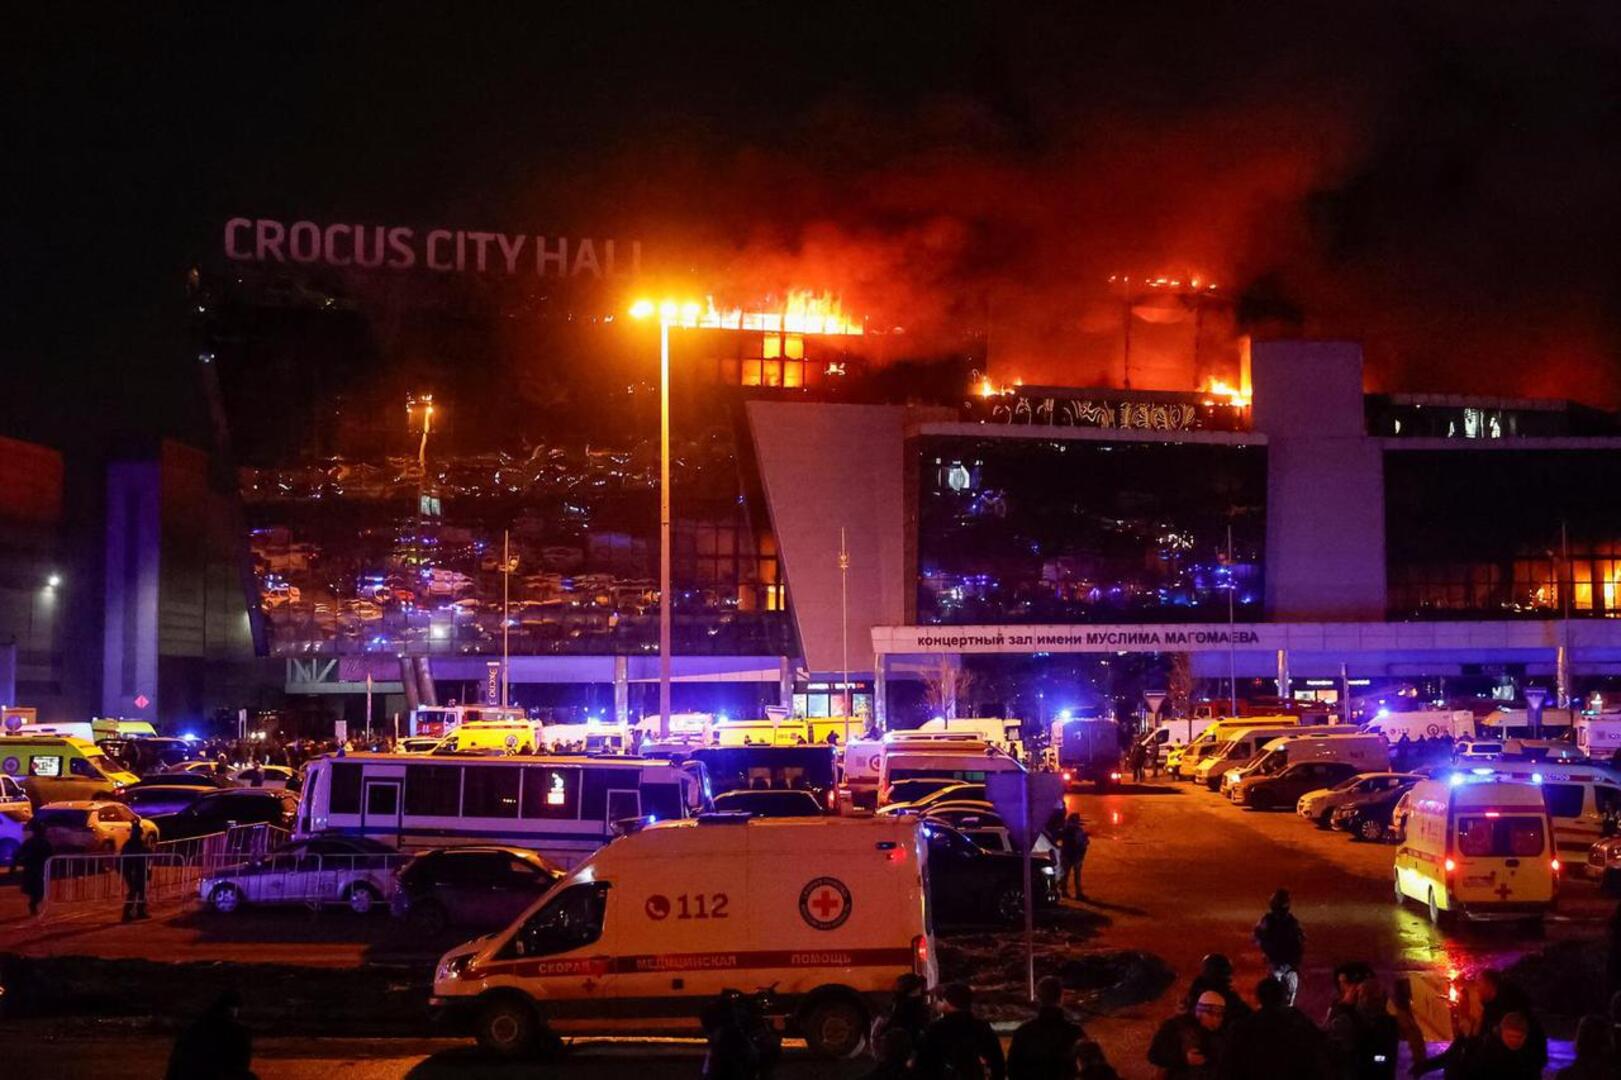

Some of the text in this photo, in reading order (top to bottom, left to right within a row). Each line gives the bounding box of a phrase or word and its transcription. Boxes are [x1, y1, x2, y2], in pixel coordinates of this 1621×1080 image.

[223, 217, 416, 269] CROCUS
[426, 229, 526, 274] CITY
[917, 631, 1259, 649] концертный зал имени МУСЛИМА МАГОМАЕВА
[677, 893, 729, 919] 112
[791, 952, 852, 965] ПОМОЩЬ
